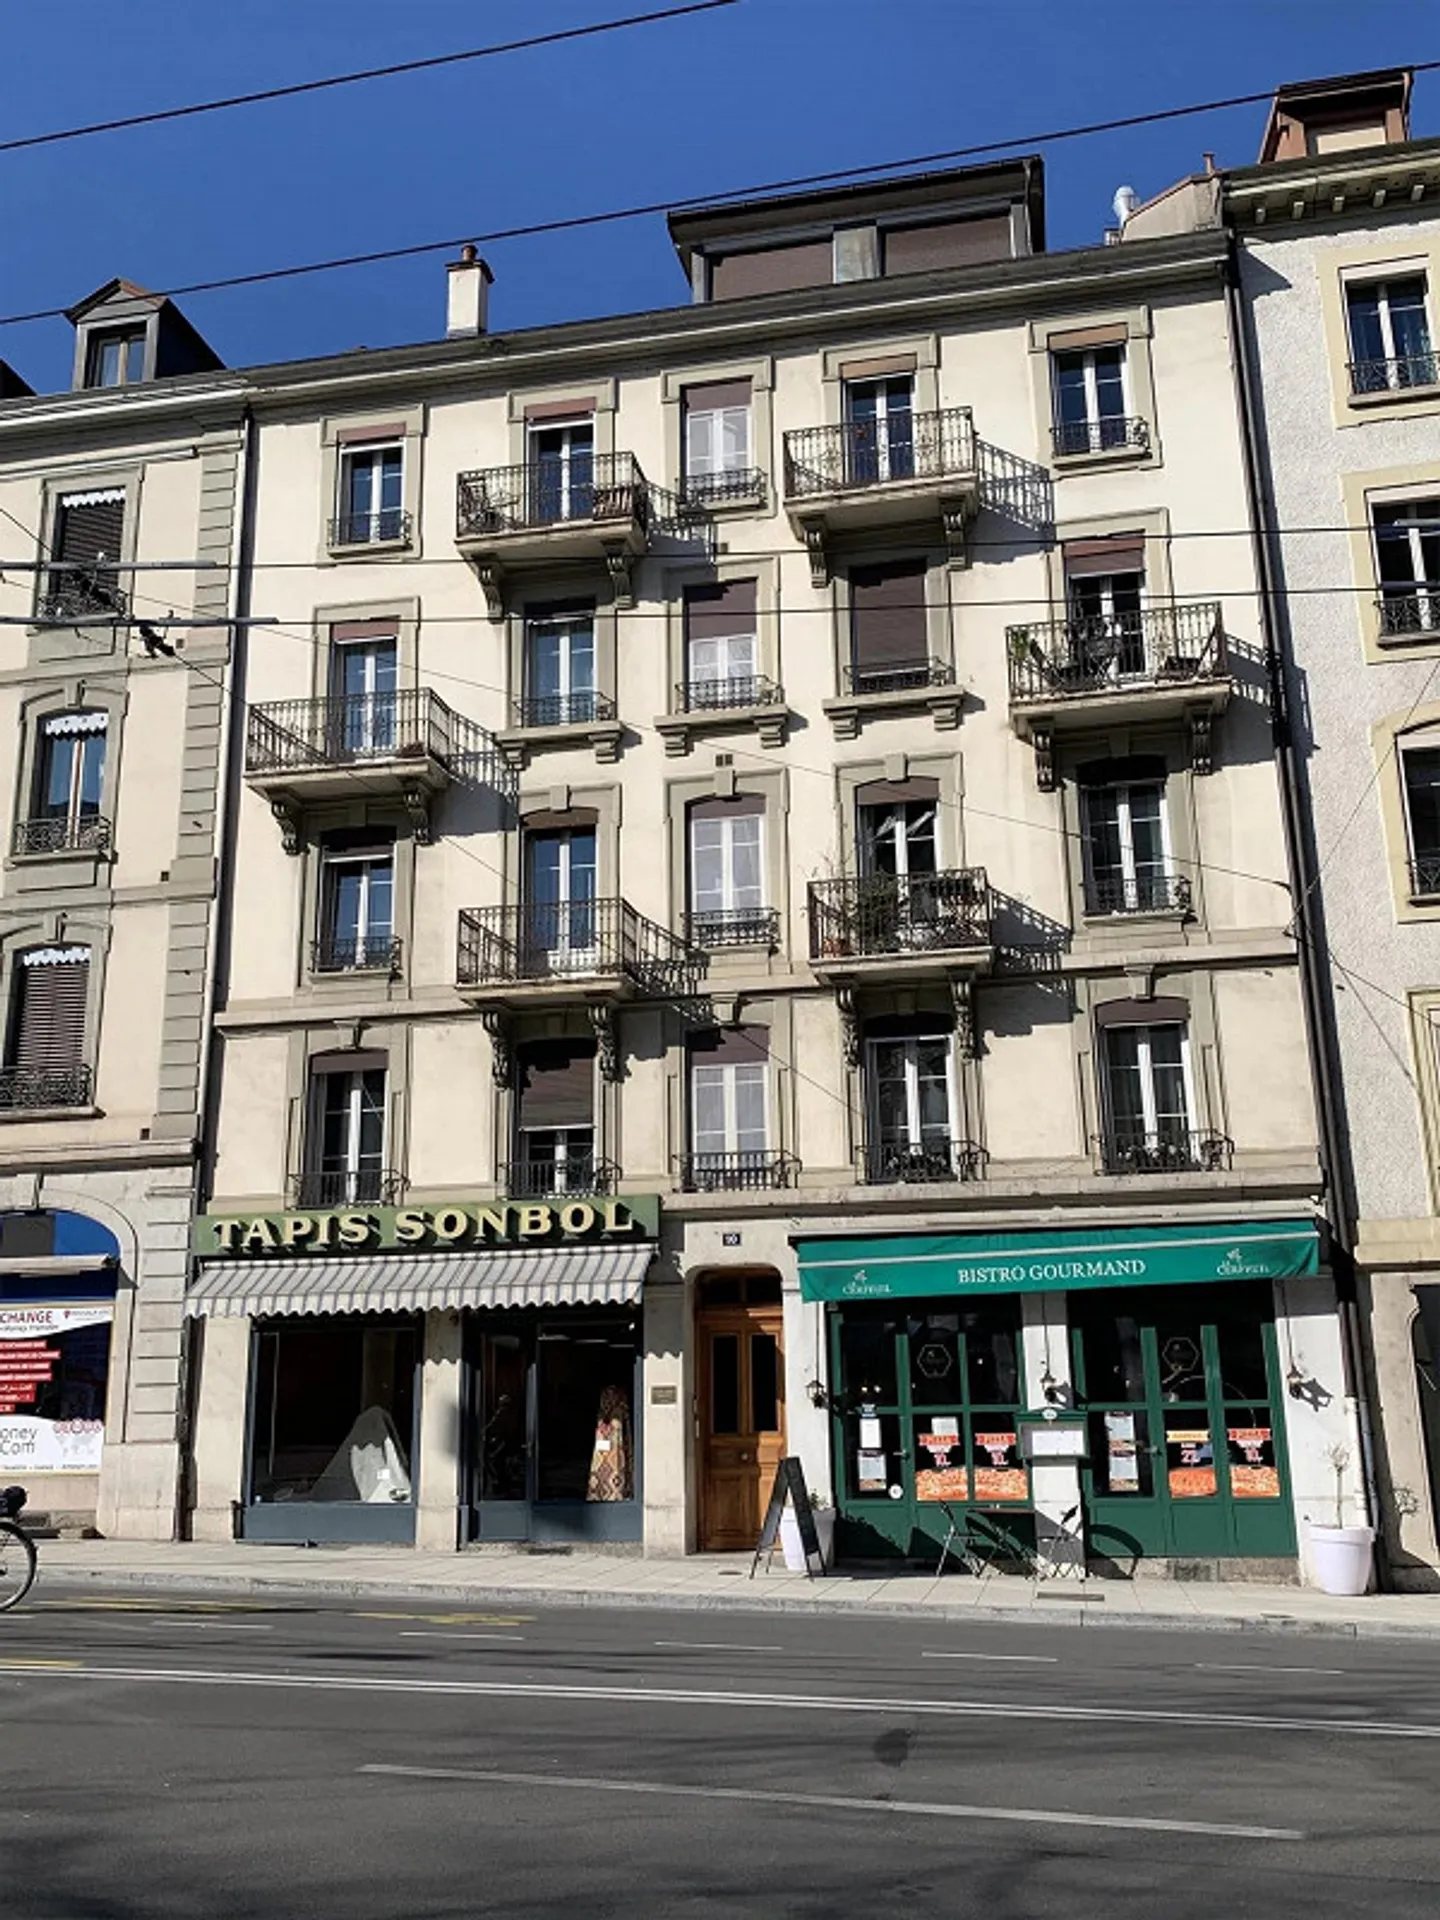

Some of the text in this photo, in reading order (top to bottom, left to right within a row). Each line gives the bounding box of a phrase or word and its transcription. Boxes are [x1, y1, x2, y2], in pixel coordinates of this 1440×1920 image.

[212, 1201, 634, 1247] TAPIS SONBOL
[957, 1259, 1147, 1284] BISTRO GOURMAND
